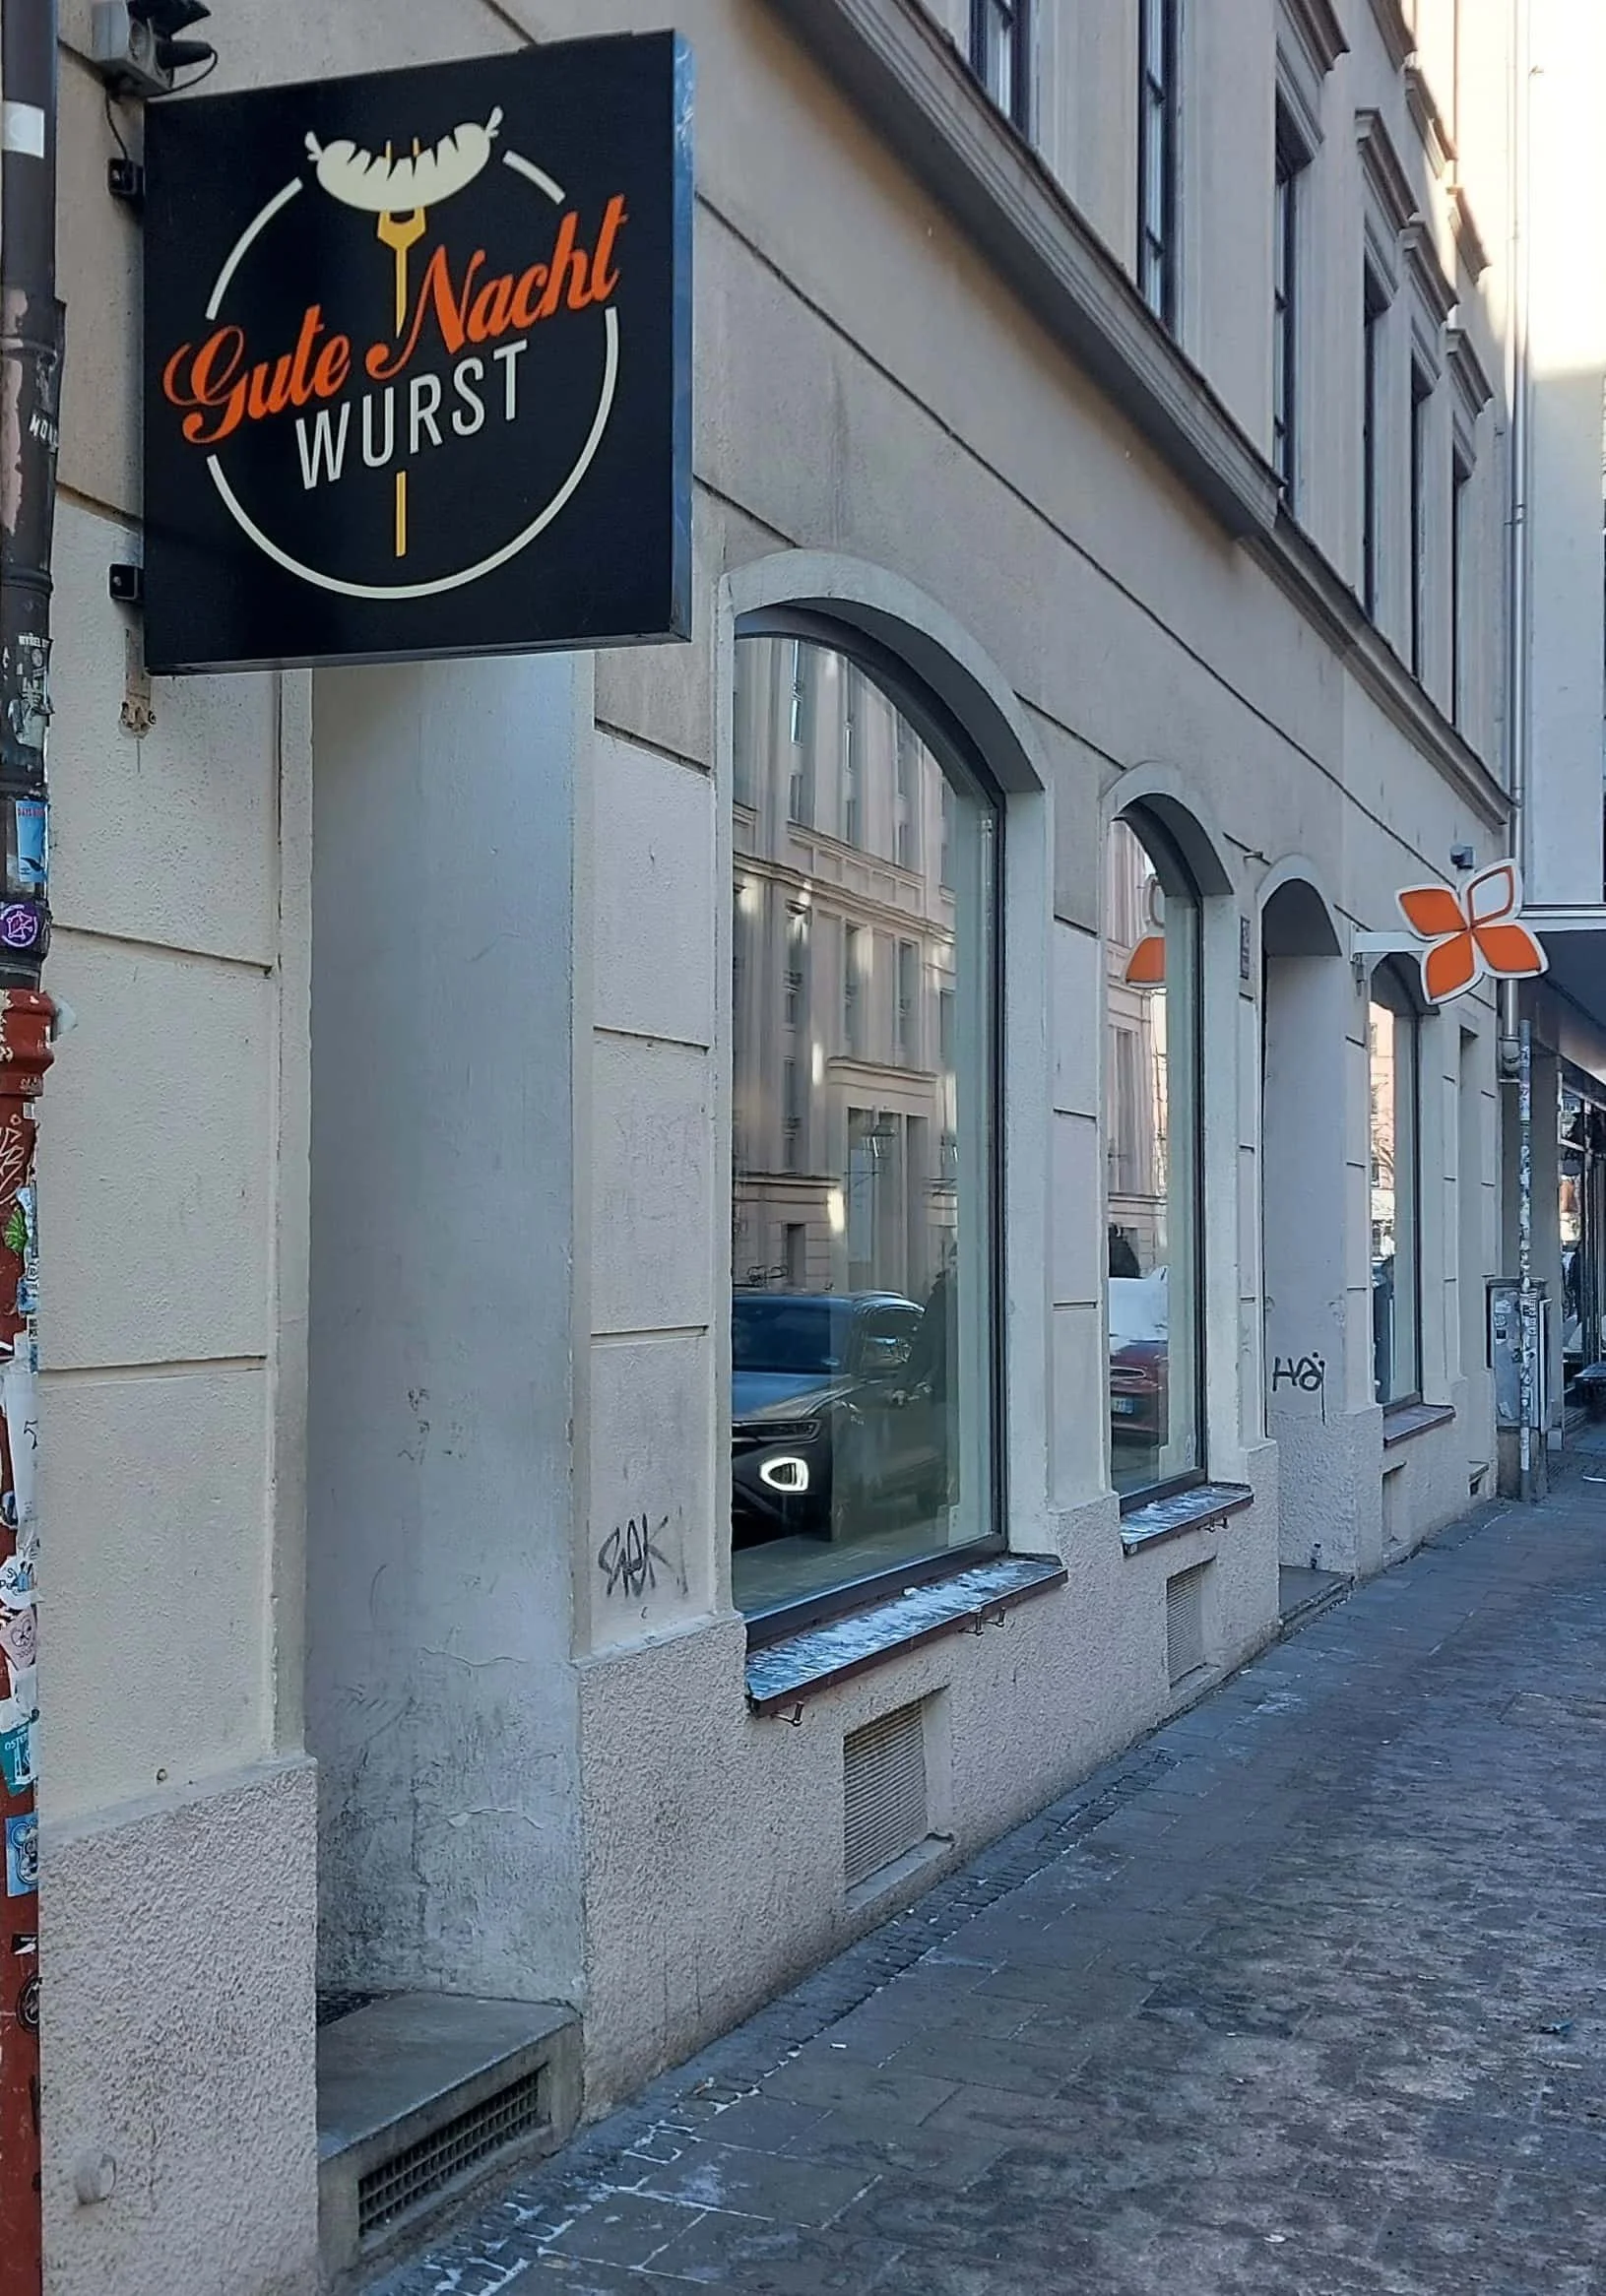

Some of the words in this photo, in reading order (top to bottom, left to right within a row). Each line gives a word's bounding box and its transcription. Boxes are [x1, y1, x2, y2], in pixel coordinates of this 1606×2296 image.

[161, 304, 352, 445] Gute
[364, 193, 628, 382] Nacht
[294, 340, 528, 491] WURST
